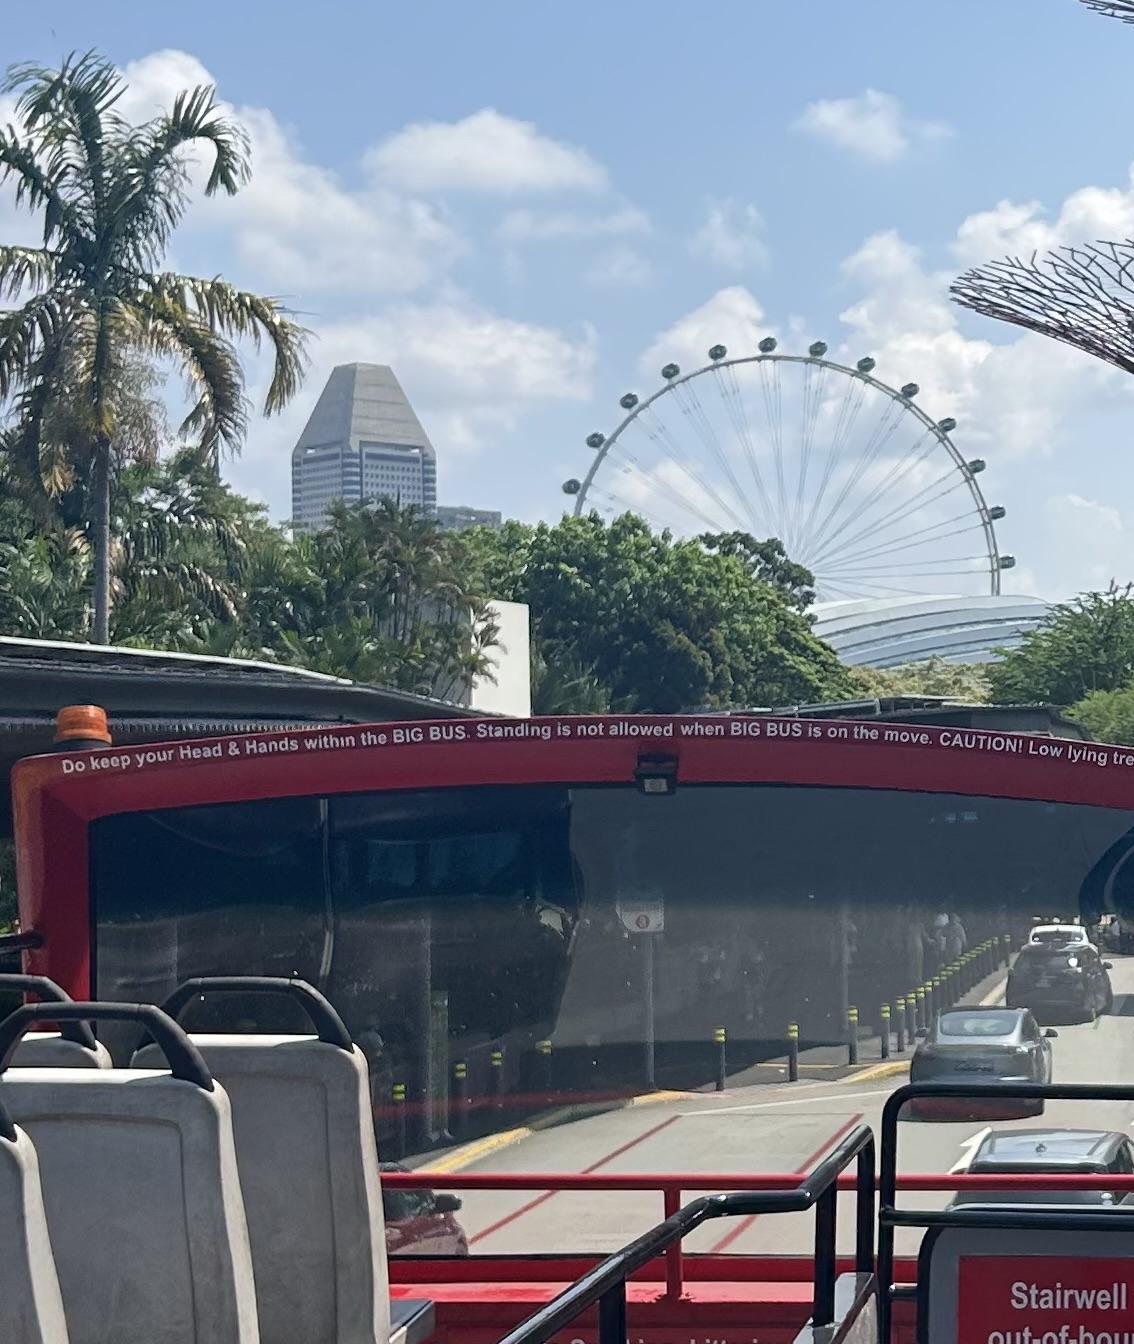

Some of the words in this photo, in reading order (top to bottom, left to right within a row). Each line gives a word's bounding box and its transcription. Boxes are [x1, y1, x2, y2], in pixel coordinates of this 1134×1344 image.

[62, 759, 85, 773] Do
[91, 755, 130, 770] keep
[137, 748, 173, 766] your
[180, 743, 222, 760] Head
[228, 741, 240, 755] &
[245, 737, 299, 755] Hands
[304, 735, 355, 750] within
[360, 732, 387, 745] the
[393, 728, 424, 743] BIG
[476, 723, 551, 739] Standing
[557, 722, 571, 736] is
[577, 723, 604, 736] not
[609, 722, 673, 736] allowed
[681, 722, 724, 736] when
[730, 722, 761, 736] BIG
[767, 723, 802, 736] BUS
[809, 724, 821, 737] is
[828, 727, 848, 738] on
[854, 726, 878, 740] the
[884, 730, 933, 745] move.
[939, 732, 1023, 753] CAUTION!
[1029, 740, 1063, 757] Low
[1068, 744, 1107, 766] lying
[1010, 1281, 1127, 1310] Stairwell
